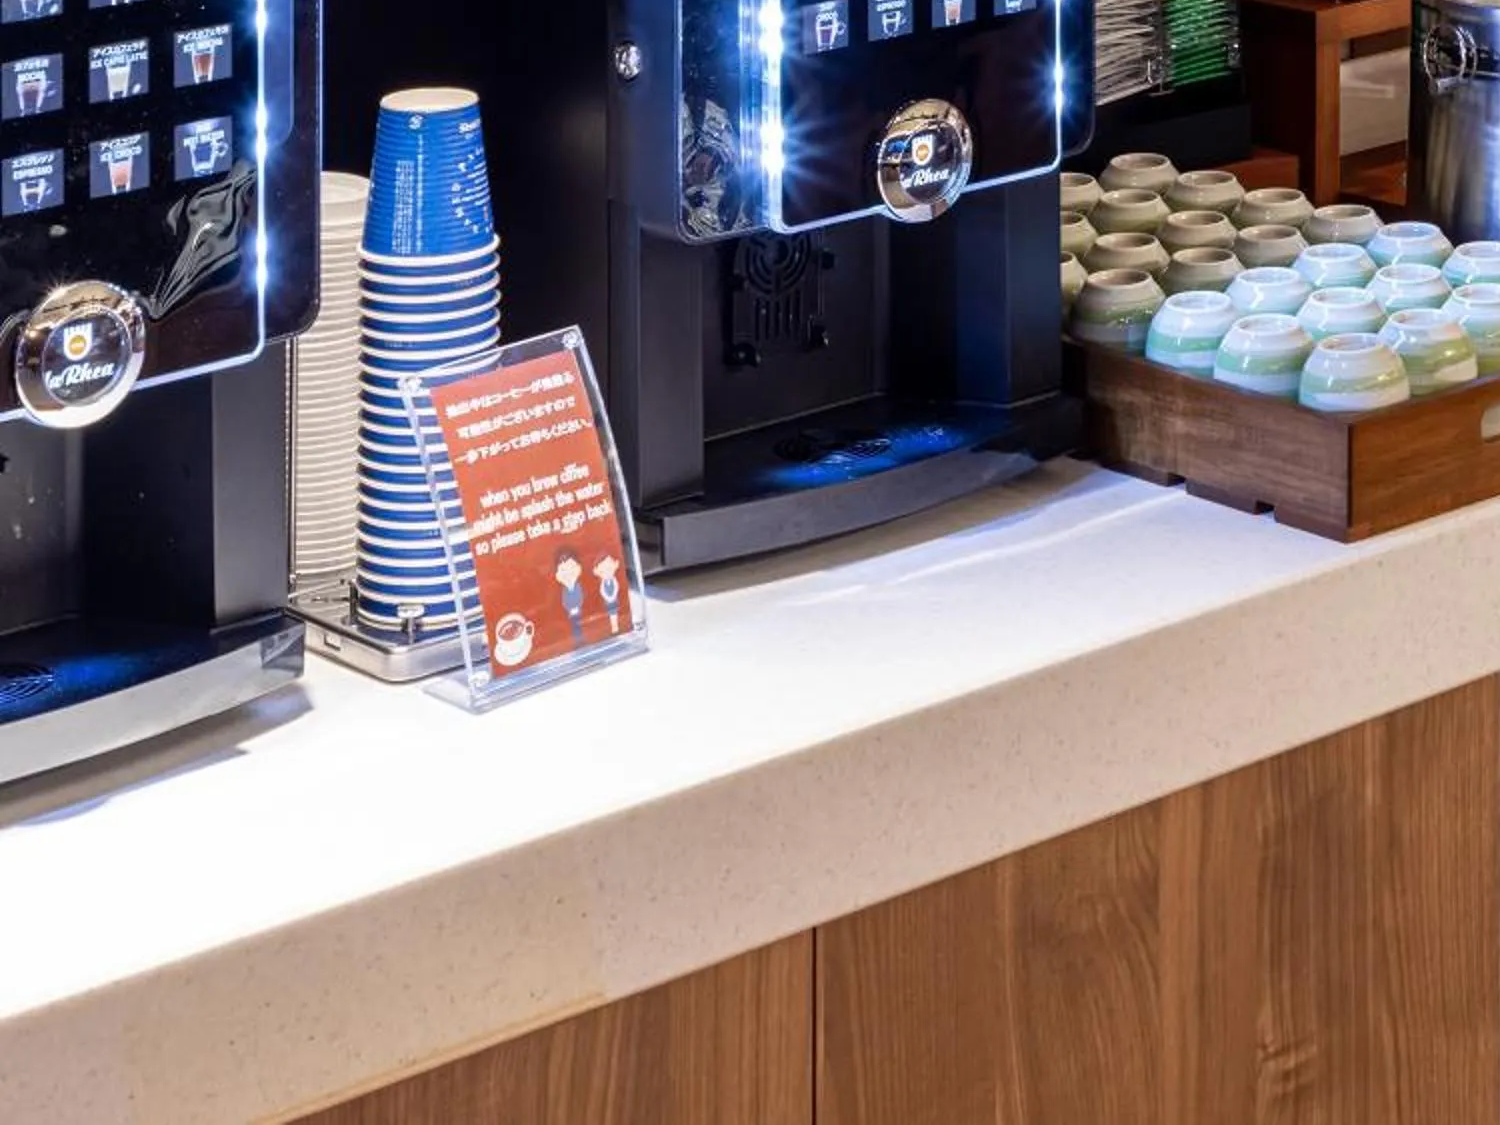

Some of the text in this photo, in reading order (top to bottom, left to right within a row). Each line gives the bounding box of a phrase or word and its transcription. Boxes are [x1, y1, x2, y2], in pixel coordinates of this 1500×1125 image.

[480, 488, 510, 508] when
[510, 482, 532, 502] you
[559, 462, 590, 484] coffee
[503, 506, 520, 523] be
[555, 489, 575, 507] the
[575, 481, 604, 501] water
[475, 540, 489, 555] so
[490, 529, 527, 554] please
[527, 518, 551, 540] take
